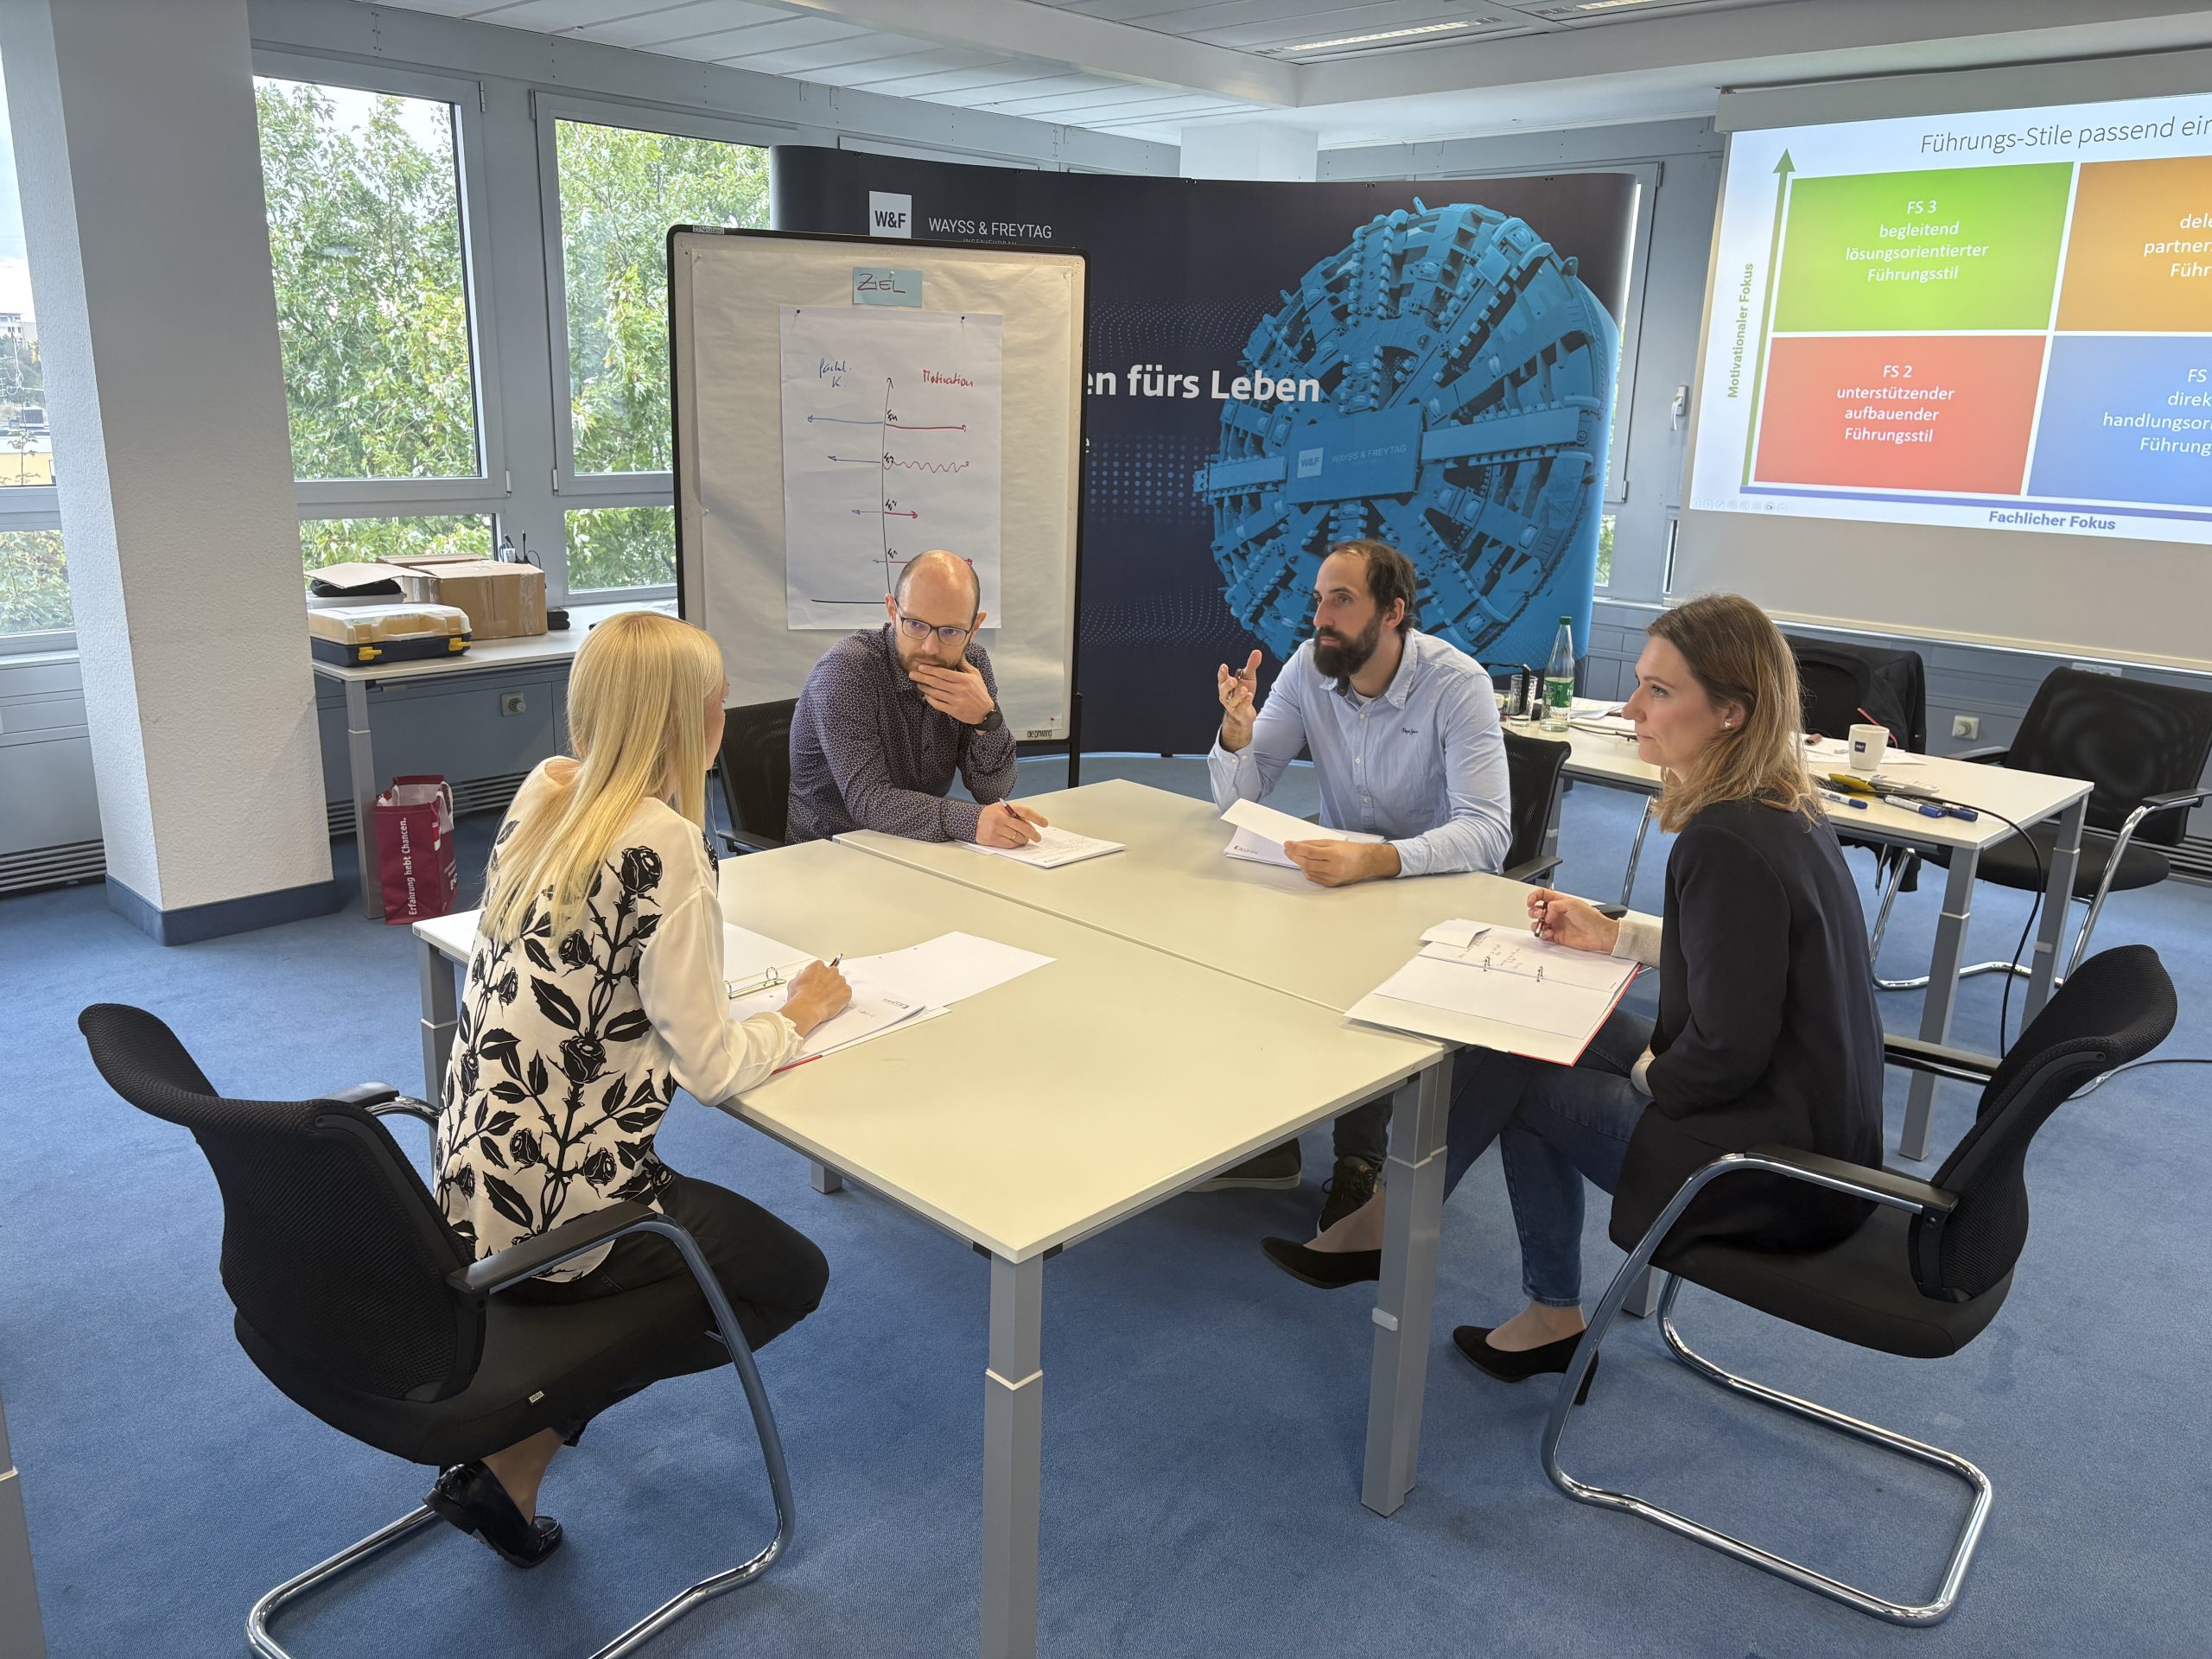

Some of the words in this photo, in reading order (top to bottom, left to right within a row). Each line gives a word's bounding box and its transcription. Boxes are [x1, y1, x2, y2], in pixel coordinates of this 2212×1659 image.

[1921, 124, 2073, 154] Führungs-Stile
[2078, 116, 2175, 149] passend
[1907, 200, 1923, 215] FS
[1928, 200, 1937, 213] 3
[874, 210, 906, 229] W&F
[928, 217, 975, 234] WAYSS
[978, 221, 988, 235] &
[991, 222, 1052, 238] FREYTAG
[1879, 221, 1960, 240] begleitend
[1846, 244, 1989, 262] lösungsorientierter
[2144, 239, 2212, 257] partner
[857, 273, 906, 294] ZIEL
[1867, 265, 1959, 283] Führungsstil
[1728, 306, 1748, 397] Motivationaler
[1739, 263, 1753, 302] Fokus
[1883, 365, 1900, 378] FS
[1903, 365, 1913, 378] 2
[2188, 368, 2207, 383] FS
[1127, 364, 1200, 399] fürs
[1211, 370, 1320, 402] Leben
[1837, 386, 1955, 400] unterstützender
[2167, 391, 2212, 407] direk
[1845, 406, 1940, 421] aufbauender
[1845, 427, 1934, 444] Führungsstil
[1300, 456, 1320, 467] W&F
[1332, 451, 1358, 463] WAYSS
[1360, 450, 1366, 459] &
[1368, 444, 1407, 457] FREYTAG
[1989, 511, 2066, 527] Fachlicher
[2069, 516, 2116, 530] Fokus
[400, 817, 410, 854] Chancen.
[402, 855, 412, 875] hebt
[407, 877, 417, 915] Erfahrung
